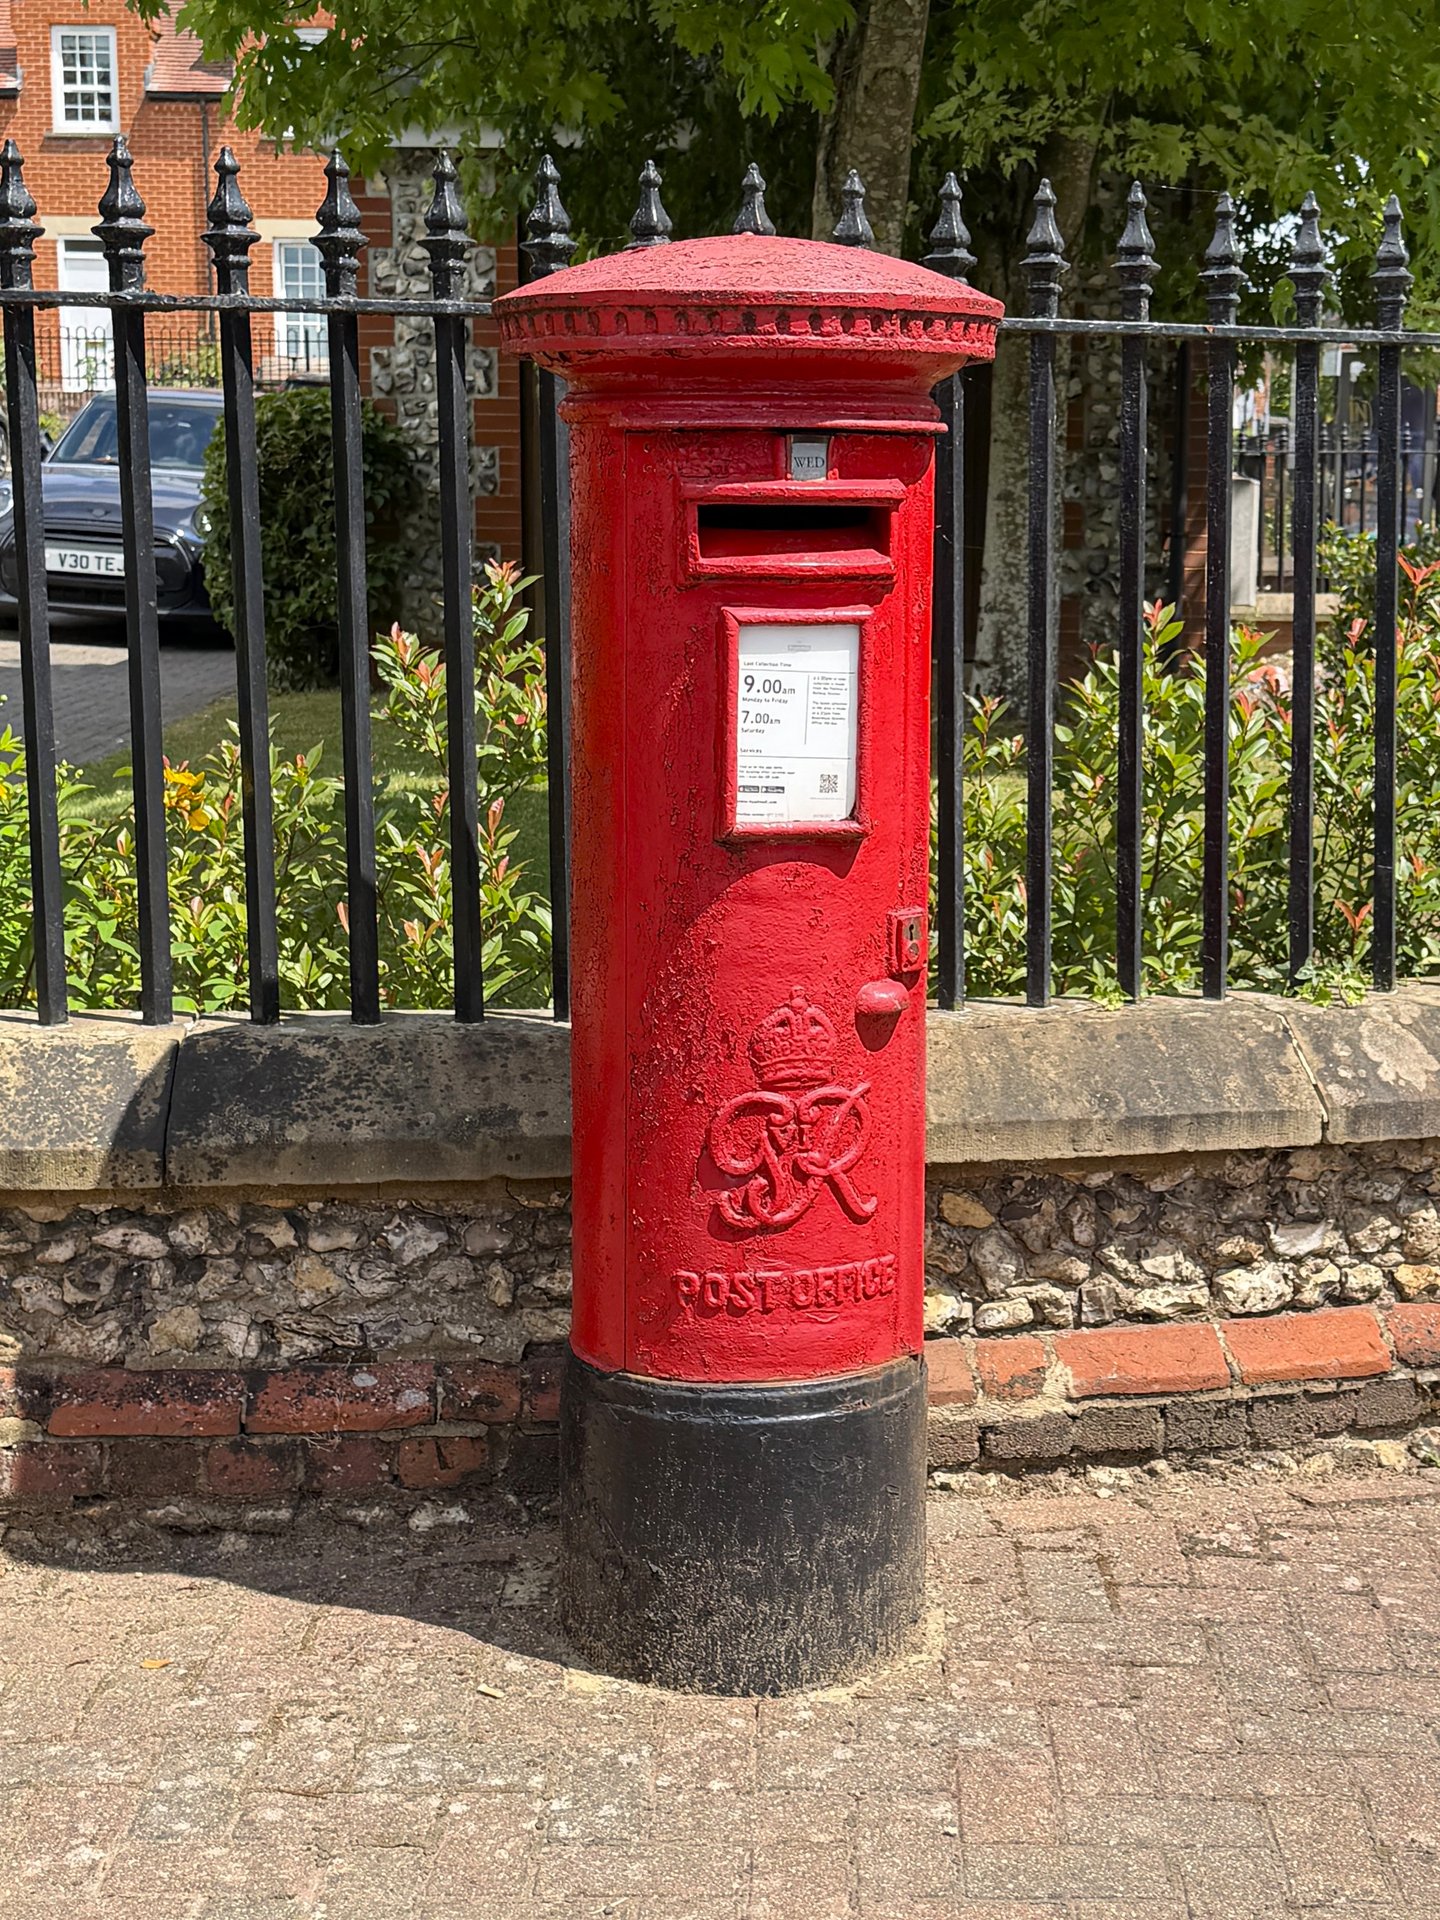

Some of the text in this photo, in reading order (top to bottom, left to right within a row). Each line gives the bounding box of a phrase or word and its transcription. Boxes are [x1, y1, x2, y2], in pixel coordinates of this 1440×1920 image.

[794, 456, 825, 468] WED
[58, 552, 124, 572] V30 TE
[744, 674, 796, 695] 9.00am
[741, 710, 781, 725] 7.00am
[674, 1253, 896, 1314] POST OFFICE
